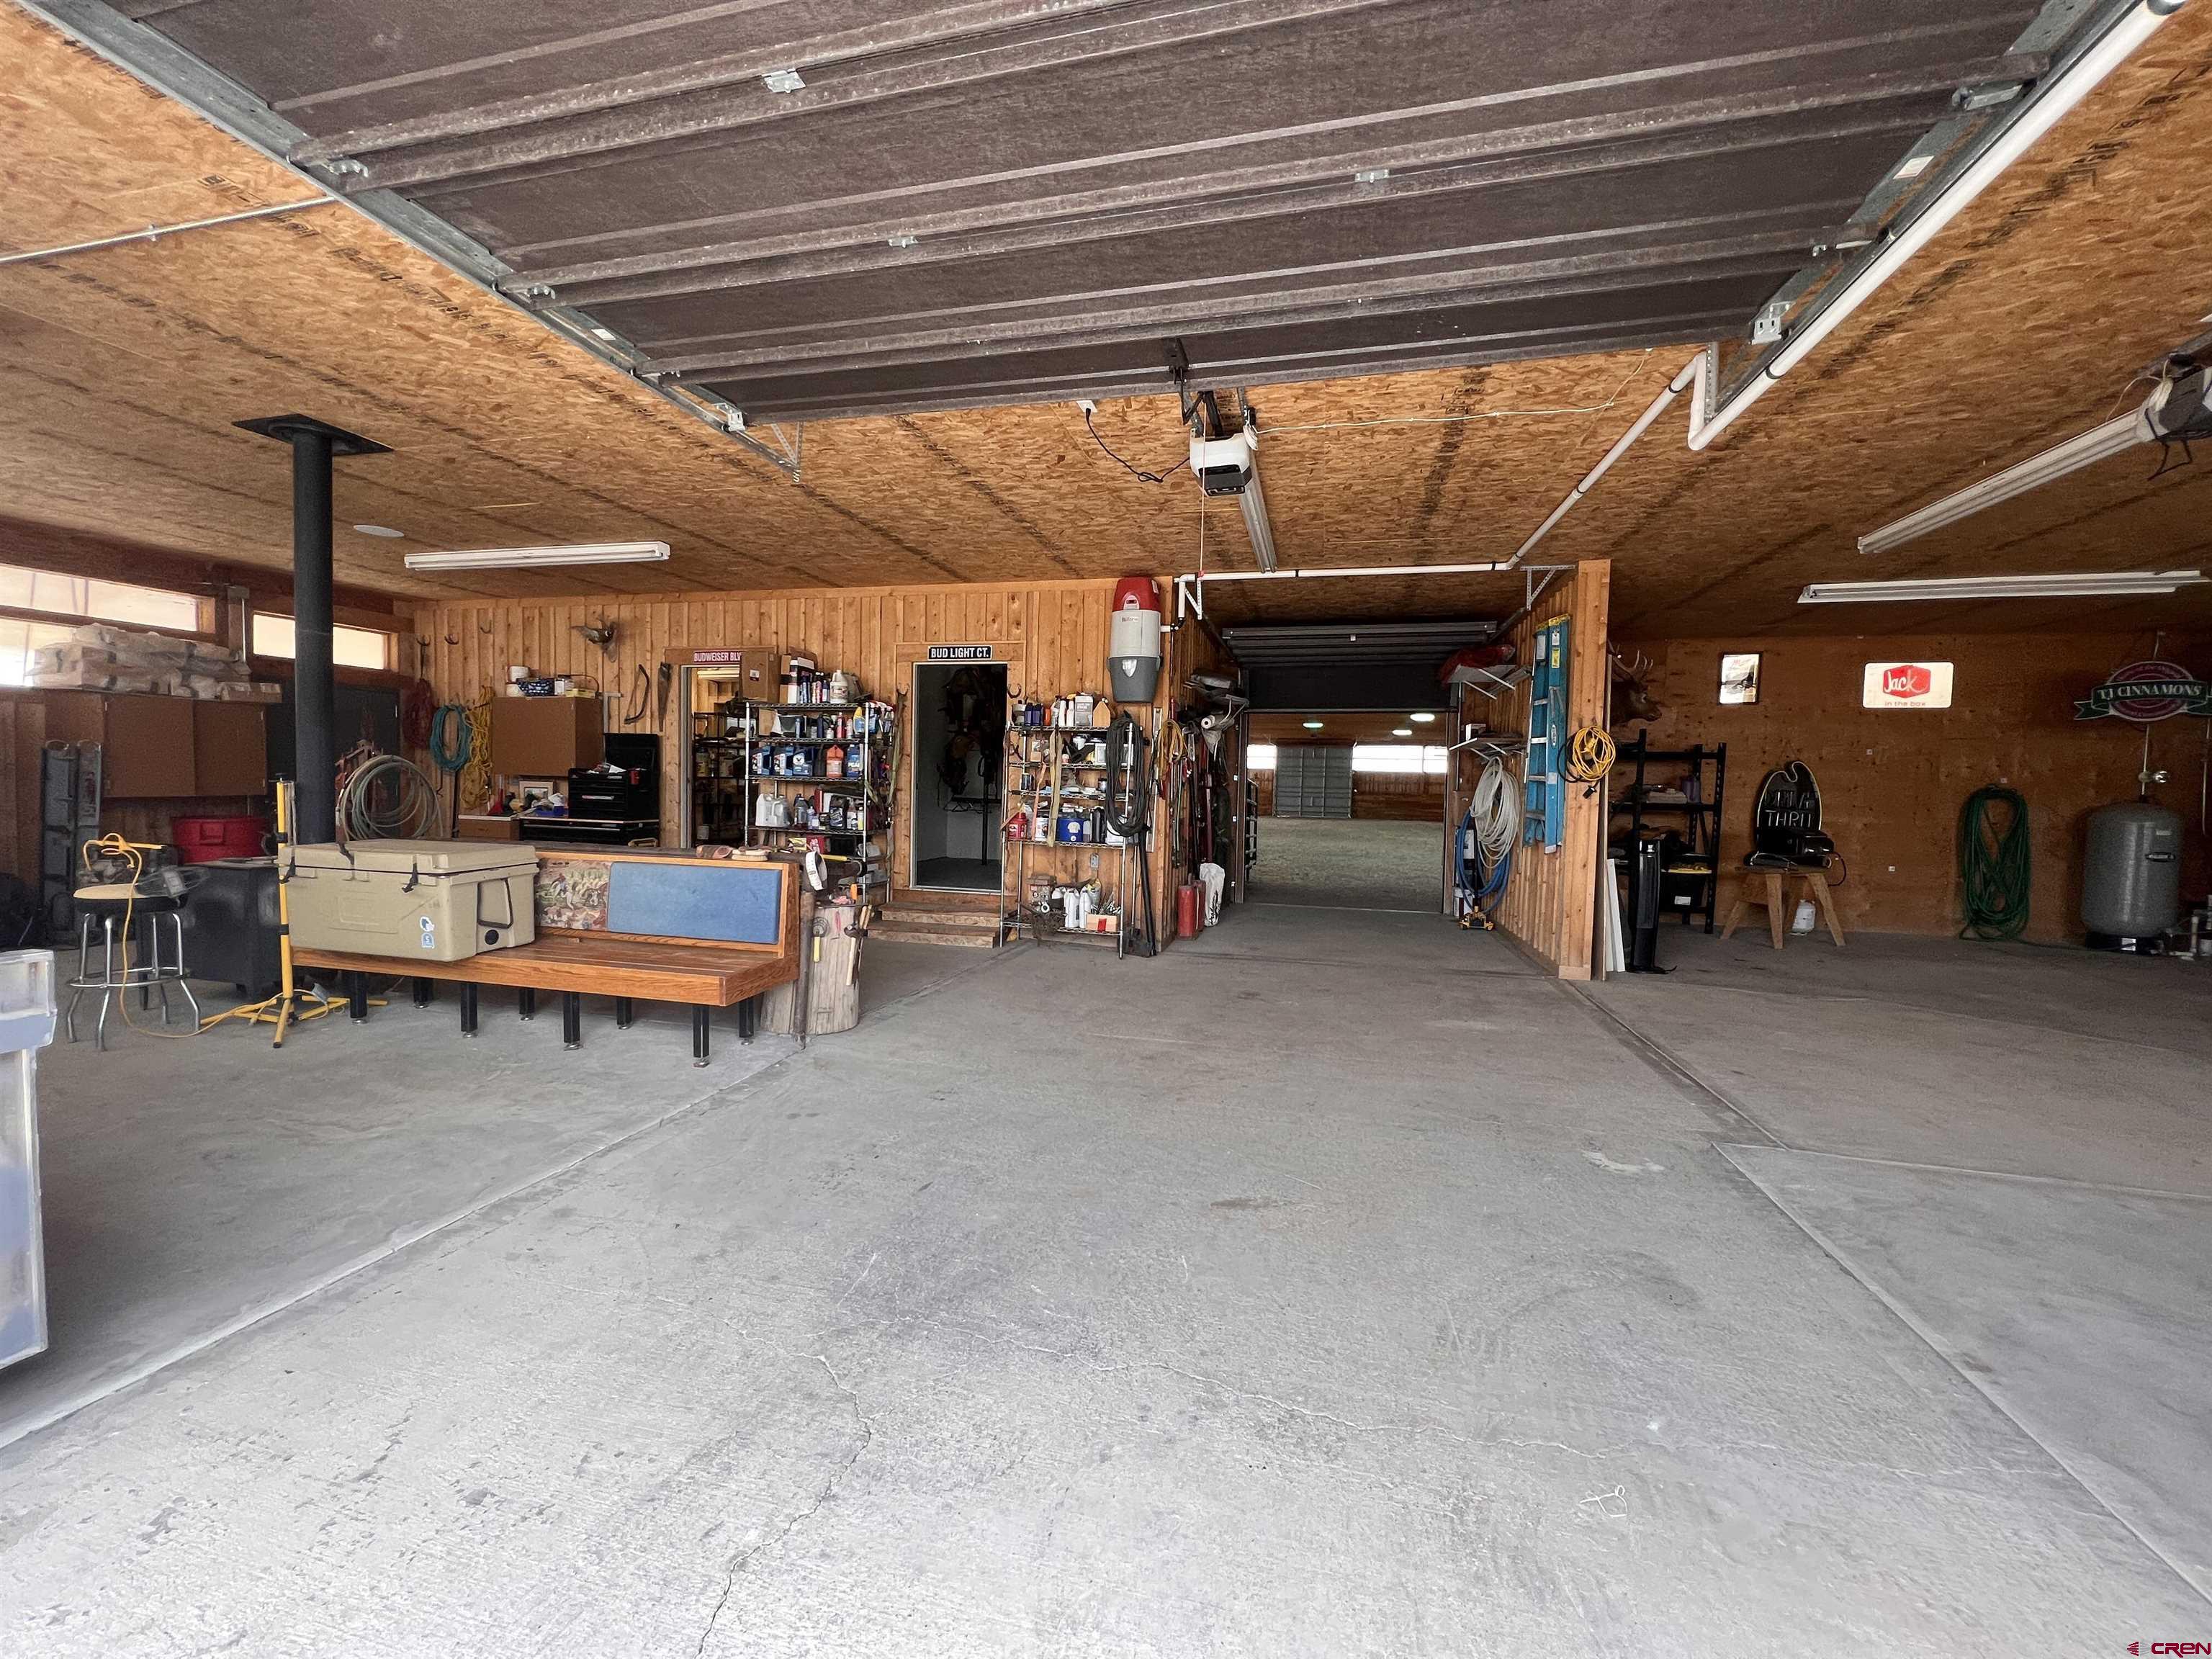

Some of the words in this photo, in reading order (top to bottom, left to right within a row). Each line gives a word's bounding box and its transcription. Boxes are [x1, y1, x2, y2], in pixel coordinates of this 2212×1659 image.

[693, 652, 729, 662] BUDWEISER
[729, 652, 741, 661] BLV
[931, 648, 948, 658] BUD
[950, 648, 975, 658] LIGHT
[976, 647, 989, 657] CT.
[1884, 670, 1930, 693] Jack
[2117, 684, 2202, 696] CINNAMONS
[1764, 809, 1811, 827] THRU
